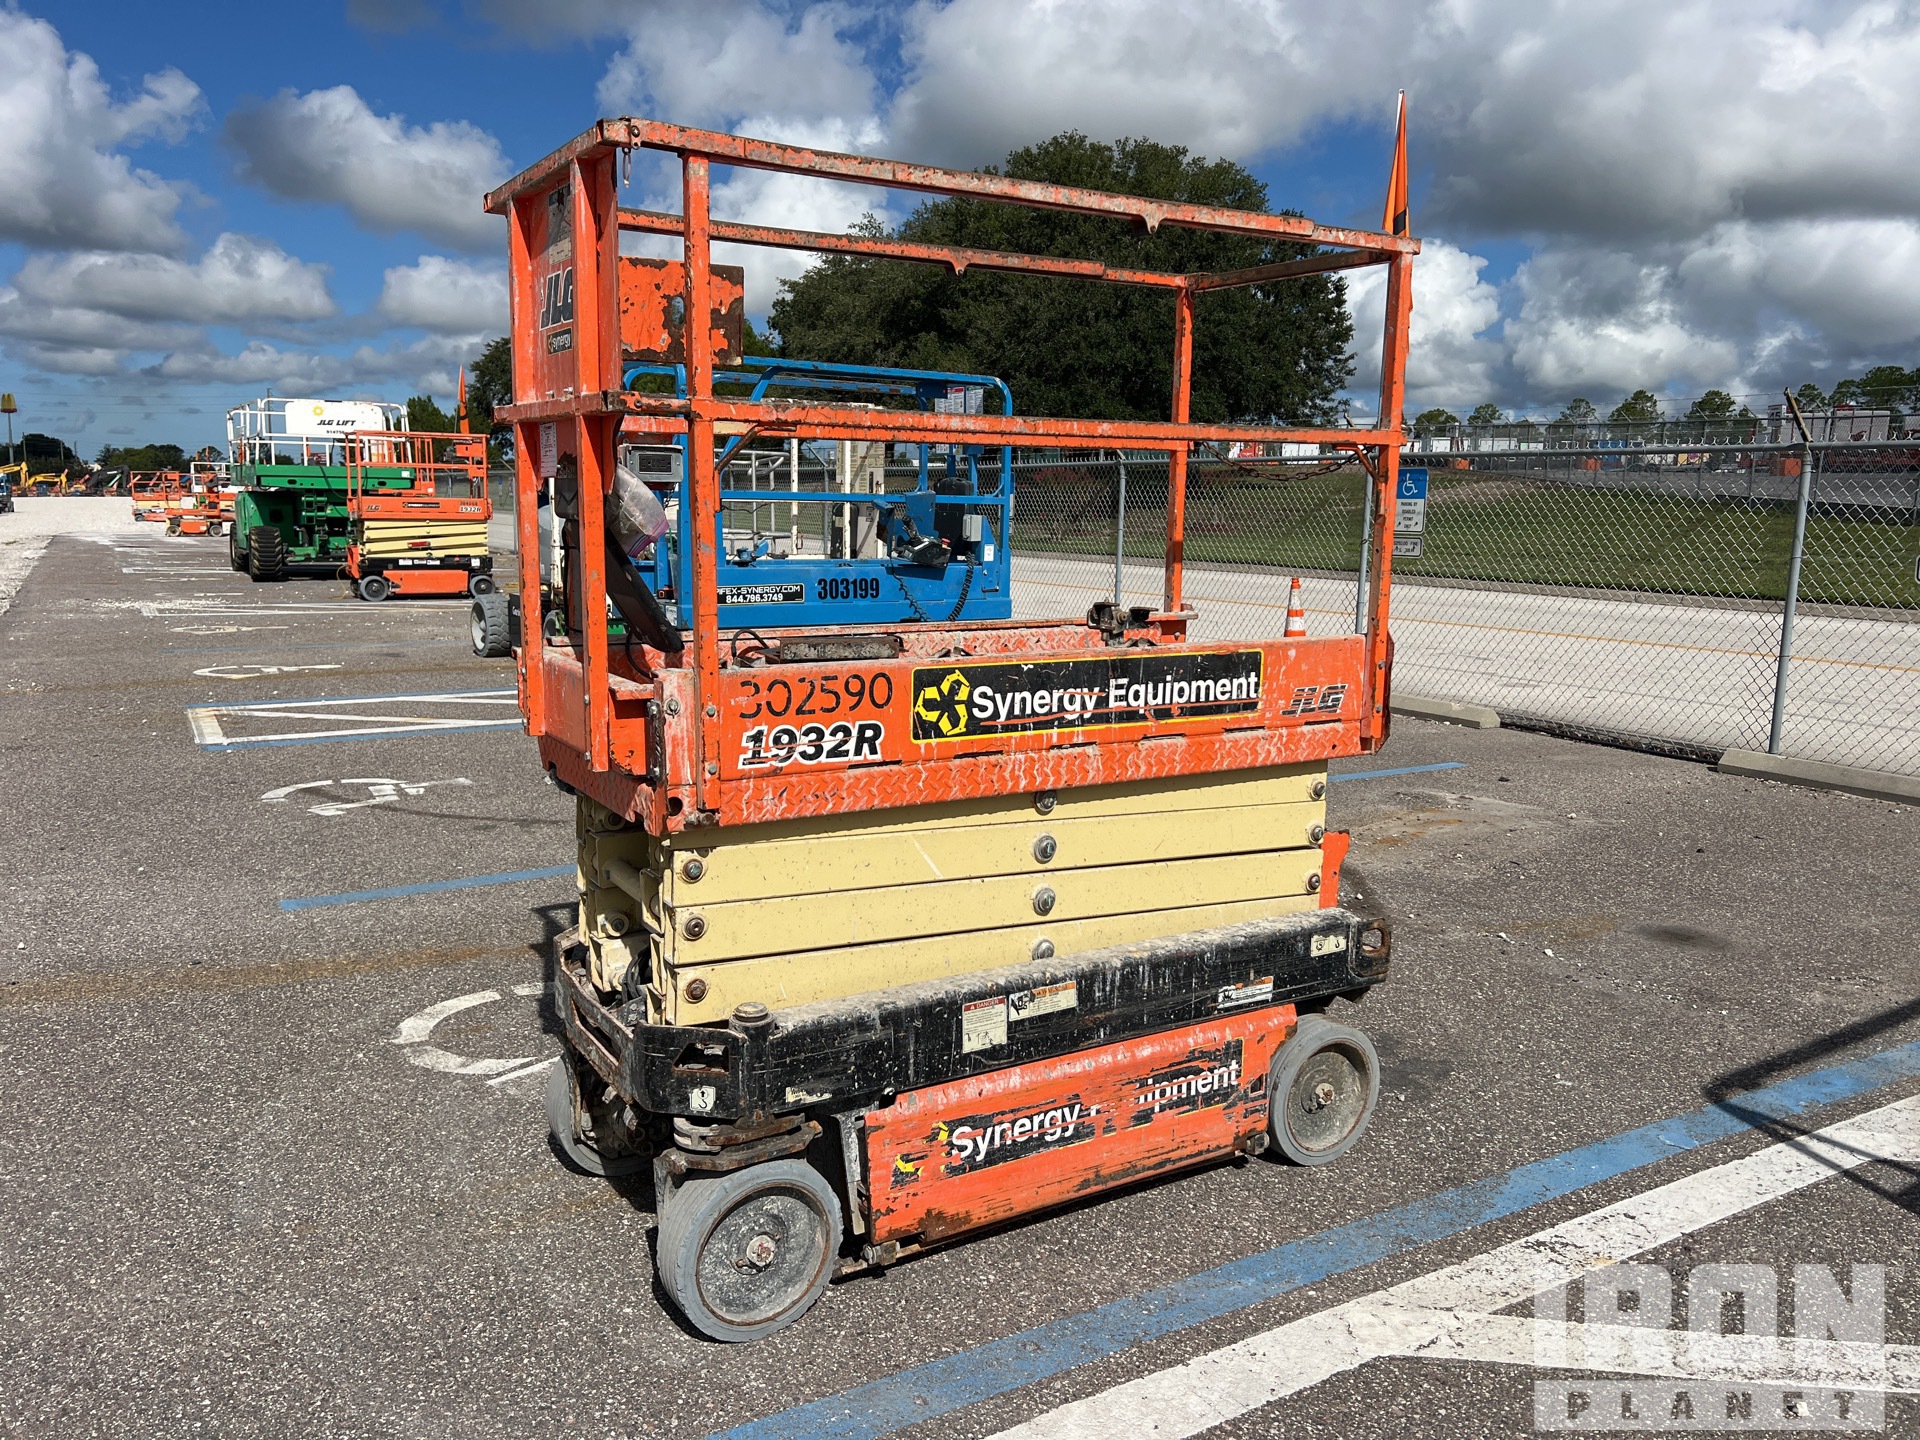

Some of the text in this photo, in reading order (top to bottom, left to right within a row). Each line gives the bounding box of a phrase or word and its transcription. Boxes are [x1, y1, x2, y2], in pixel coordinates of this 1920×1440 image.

[552, 333, 571, 350] synergy
[726, 593, 783, 604] 844.796.3749
[817, 577, 880, 600] 303199
[739, 672, 893, 719] 302590
[972, 671, 1258, 723] Synergy Equipment
[1280, 683, 1349, 718] JLG
[738, 720, 885, 769] 1932R
[976, 999, 999, 1009] DANGER
[951, 1103, 1081, 1162] Synergy
